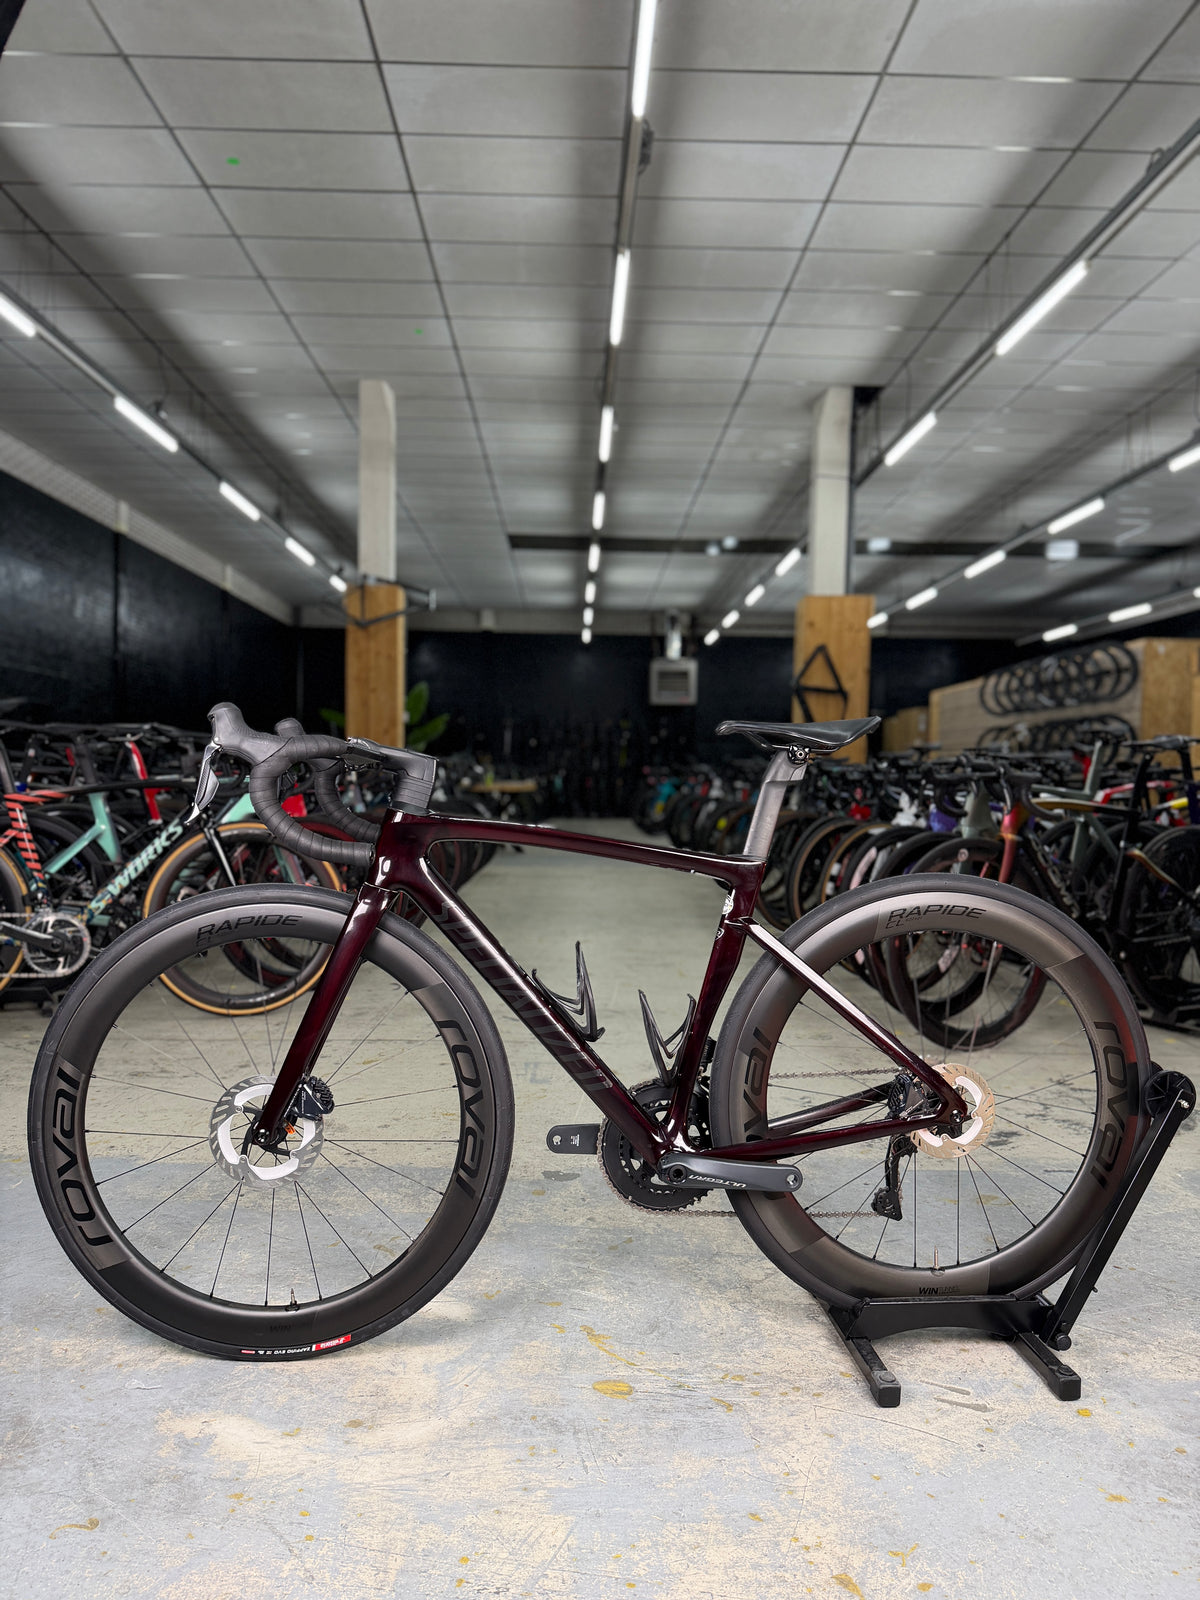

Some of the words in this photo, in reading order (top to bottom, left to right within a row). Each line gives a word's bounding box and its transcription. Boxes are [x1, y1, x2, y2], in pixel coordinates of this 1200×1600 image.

[196, 914, 303, 940] RAPIDE
[434, 900, 613, 1091] SPECIALIZED
[887, 904, 987, 922] RAPIDE
[52, 1066, 114, 1247] roval
[437, 1020, 486, 1199] roval
[687, 1173, 747, 1189] ULTEGRA
[1090, 1021, 1128, 1189] roval
